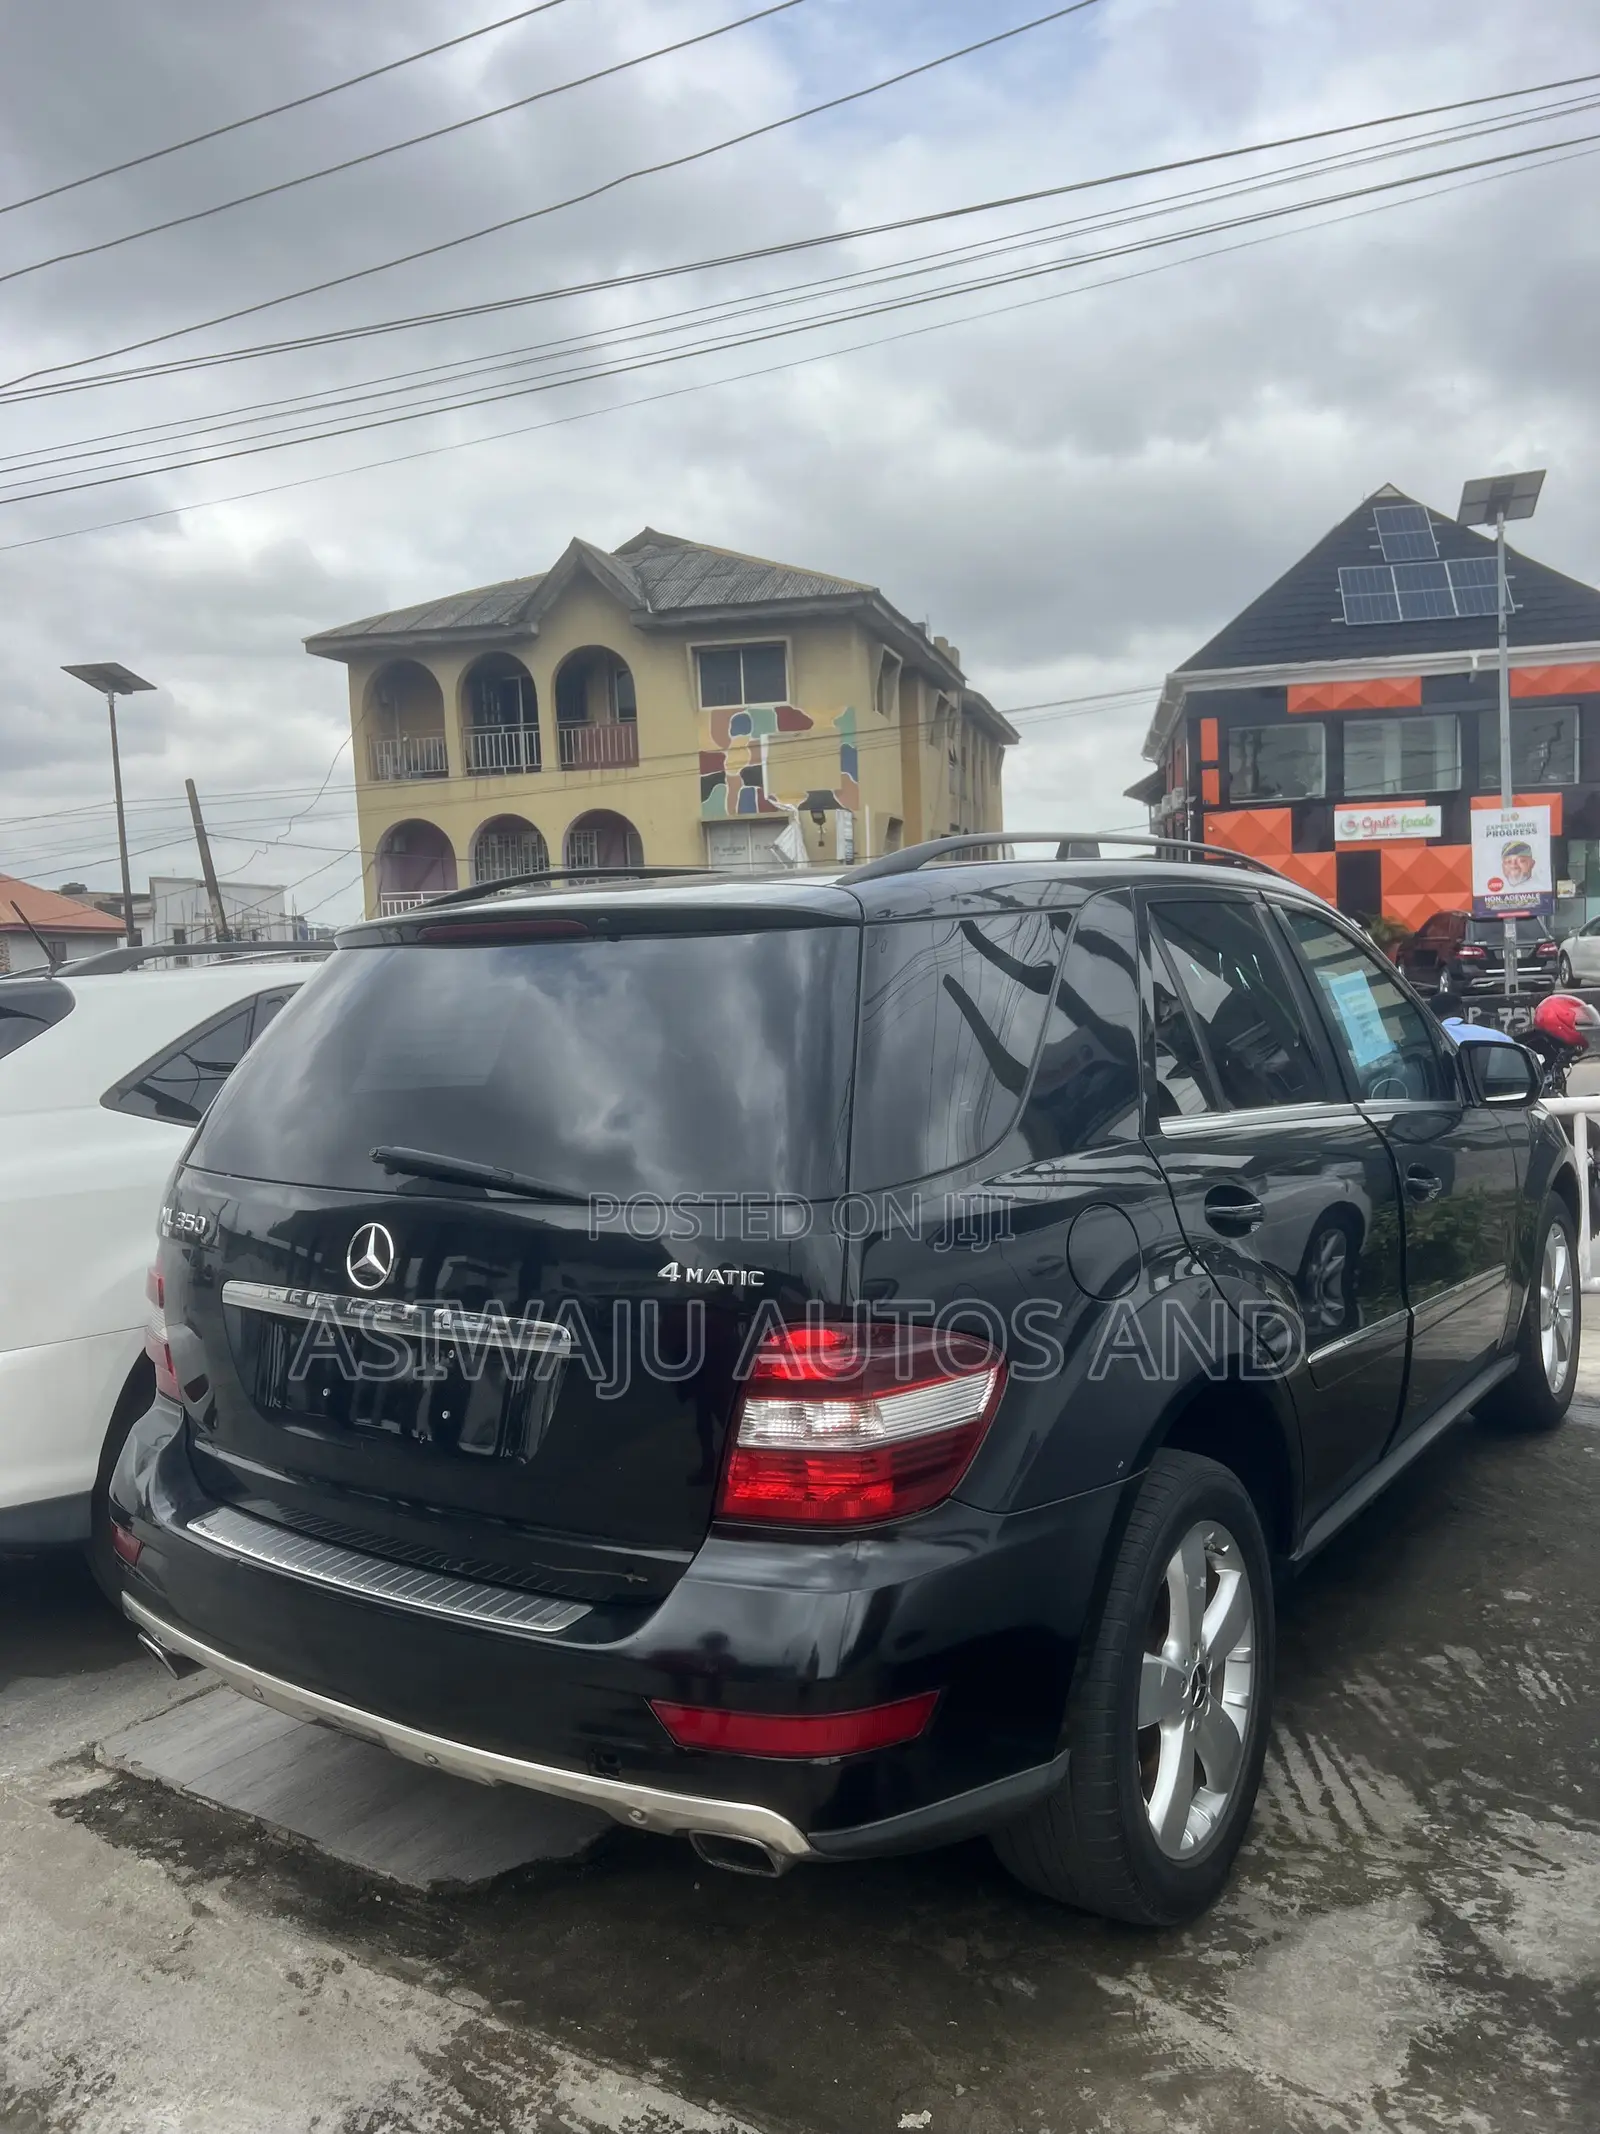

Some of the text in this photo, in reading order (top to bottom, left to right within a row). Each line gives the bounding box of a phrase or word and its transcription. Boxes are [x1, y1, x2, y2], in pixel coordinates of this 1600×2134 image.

[1486, 823, 1514, 831] EXPECT
[1486, 828, 1538, 838] PROGRESS
[1484, 893, 1541, 903] HON. ADEWALE
[175, 1211, 207, 1235] 350
